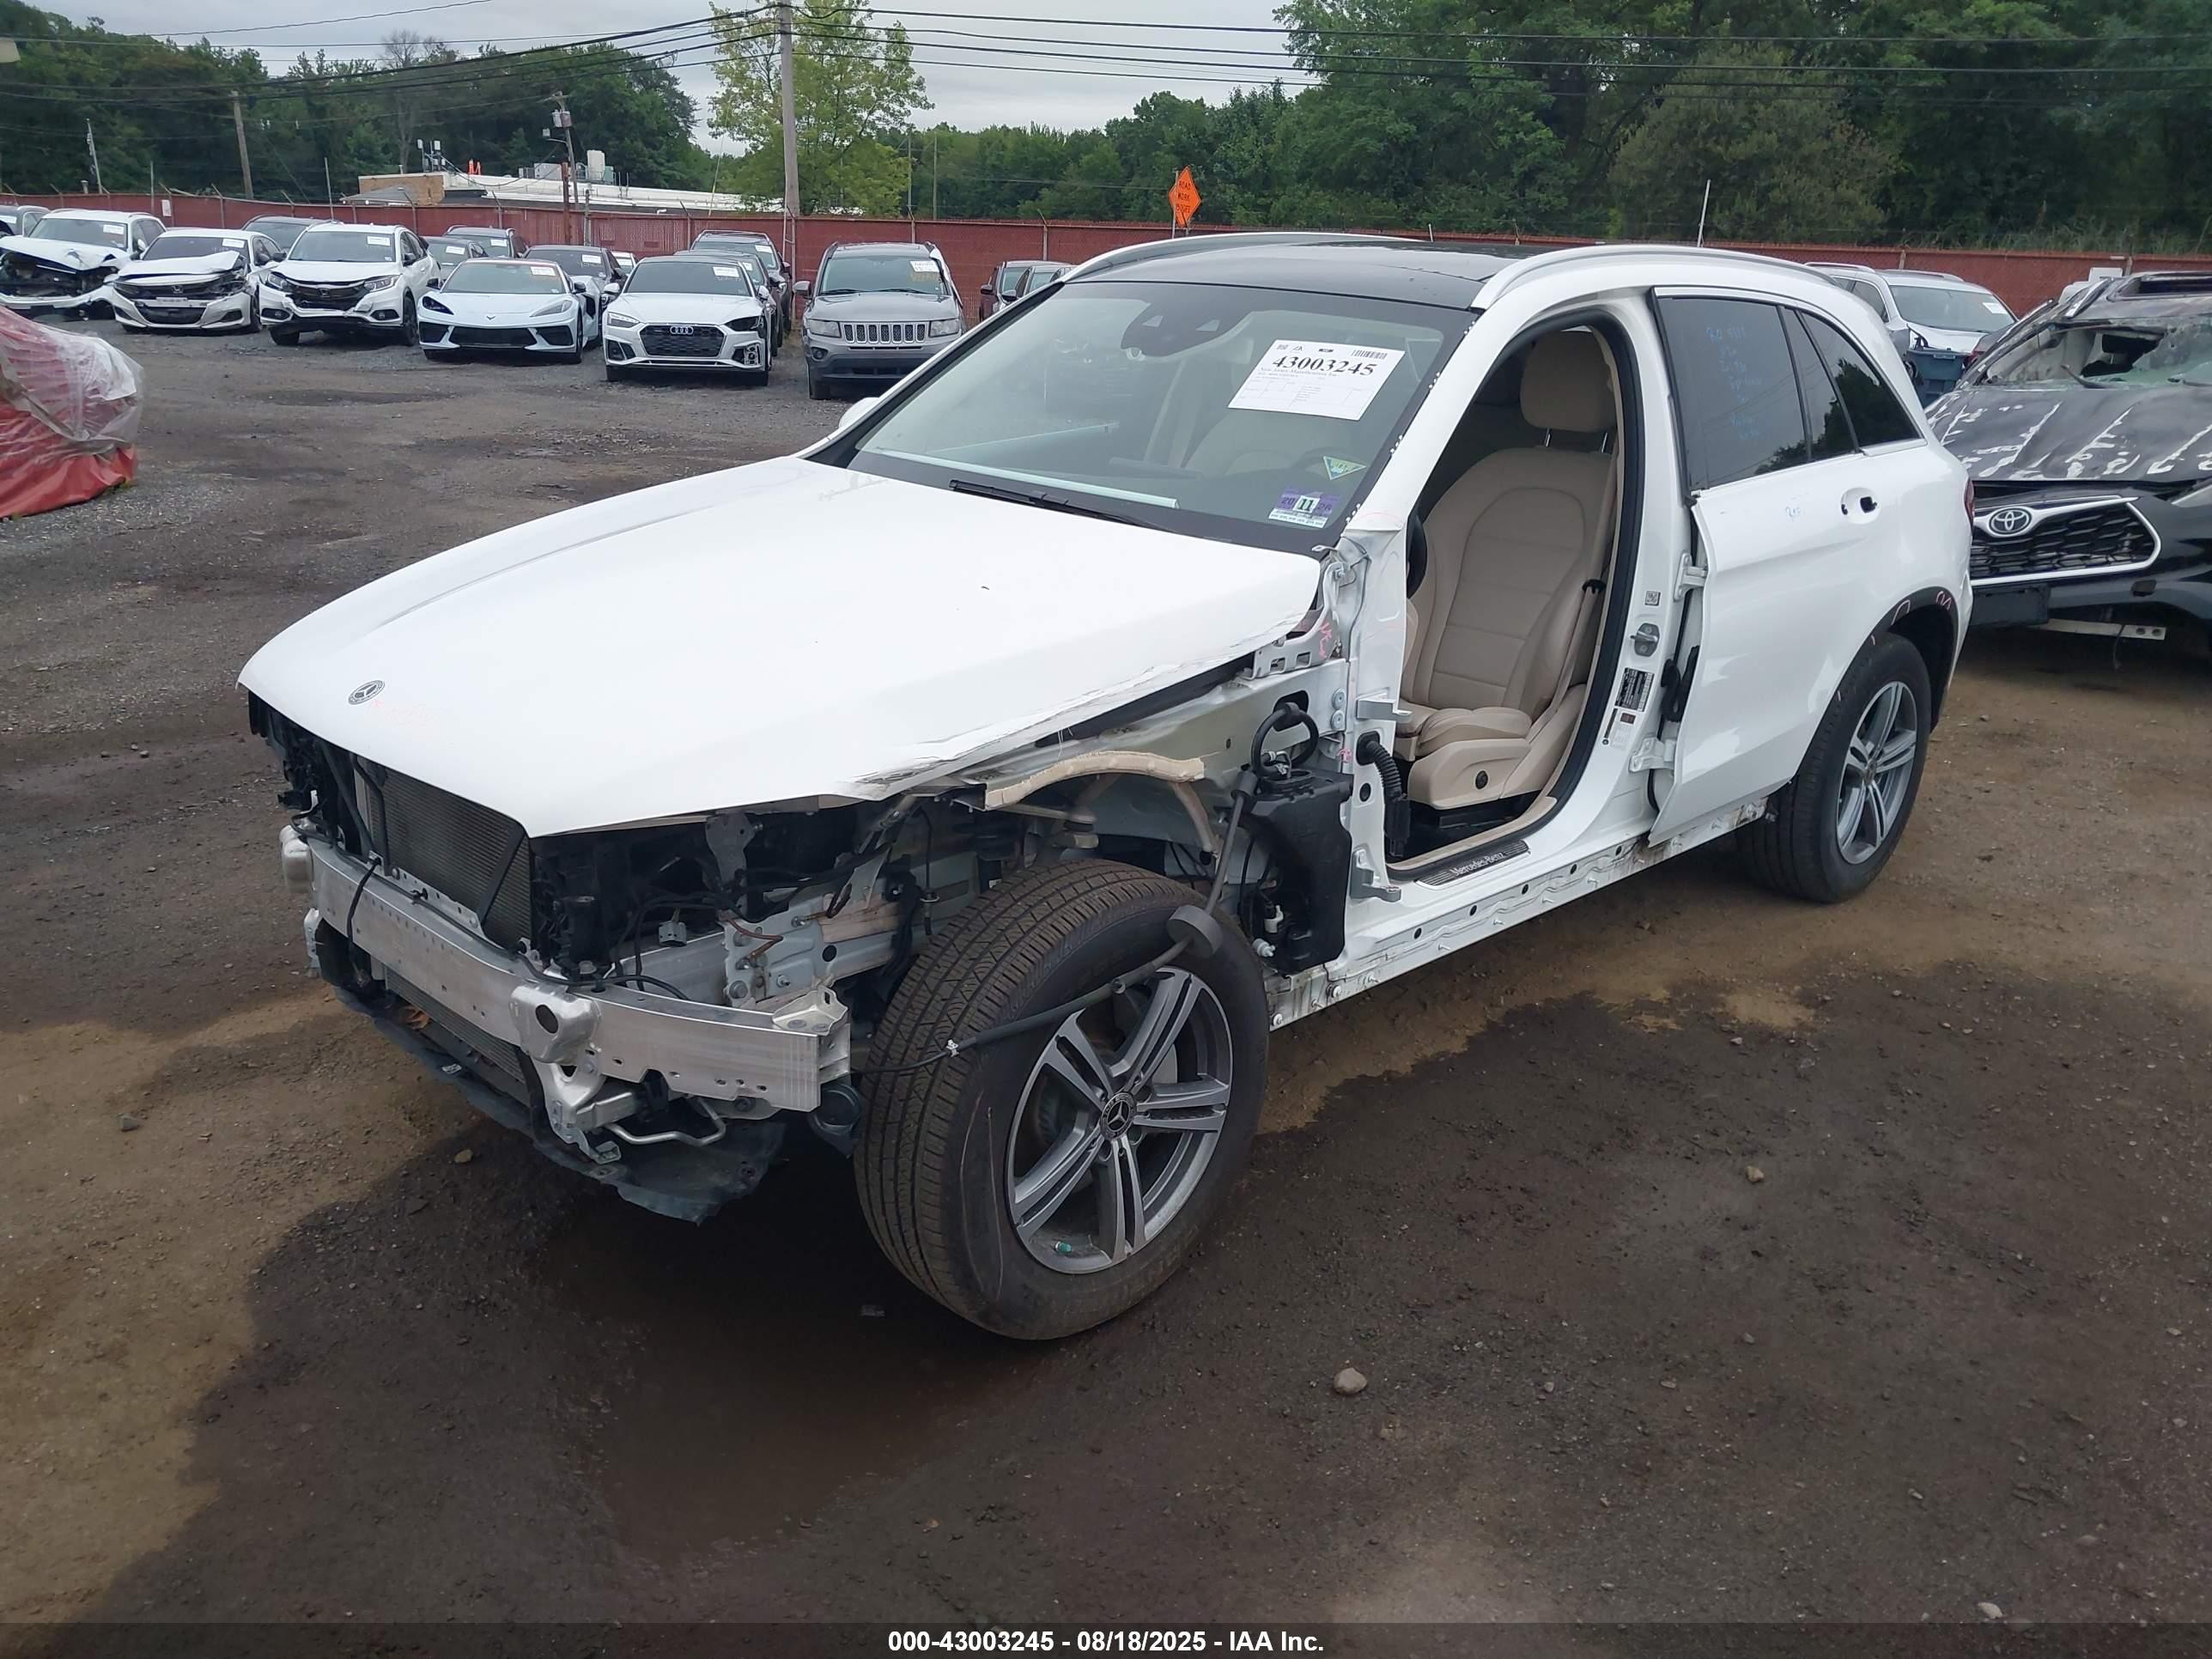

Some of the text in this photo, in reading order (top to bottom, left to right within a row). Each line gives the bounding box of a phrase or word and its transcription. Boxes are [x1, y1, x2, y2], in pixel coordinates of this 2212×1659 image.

[1272, 355, 1377, 376] 43003245
[1297, 498, 1314, 511] 11
[1449, 853, 1505, 876] Mercedes-Benz
